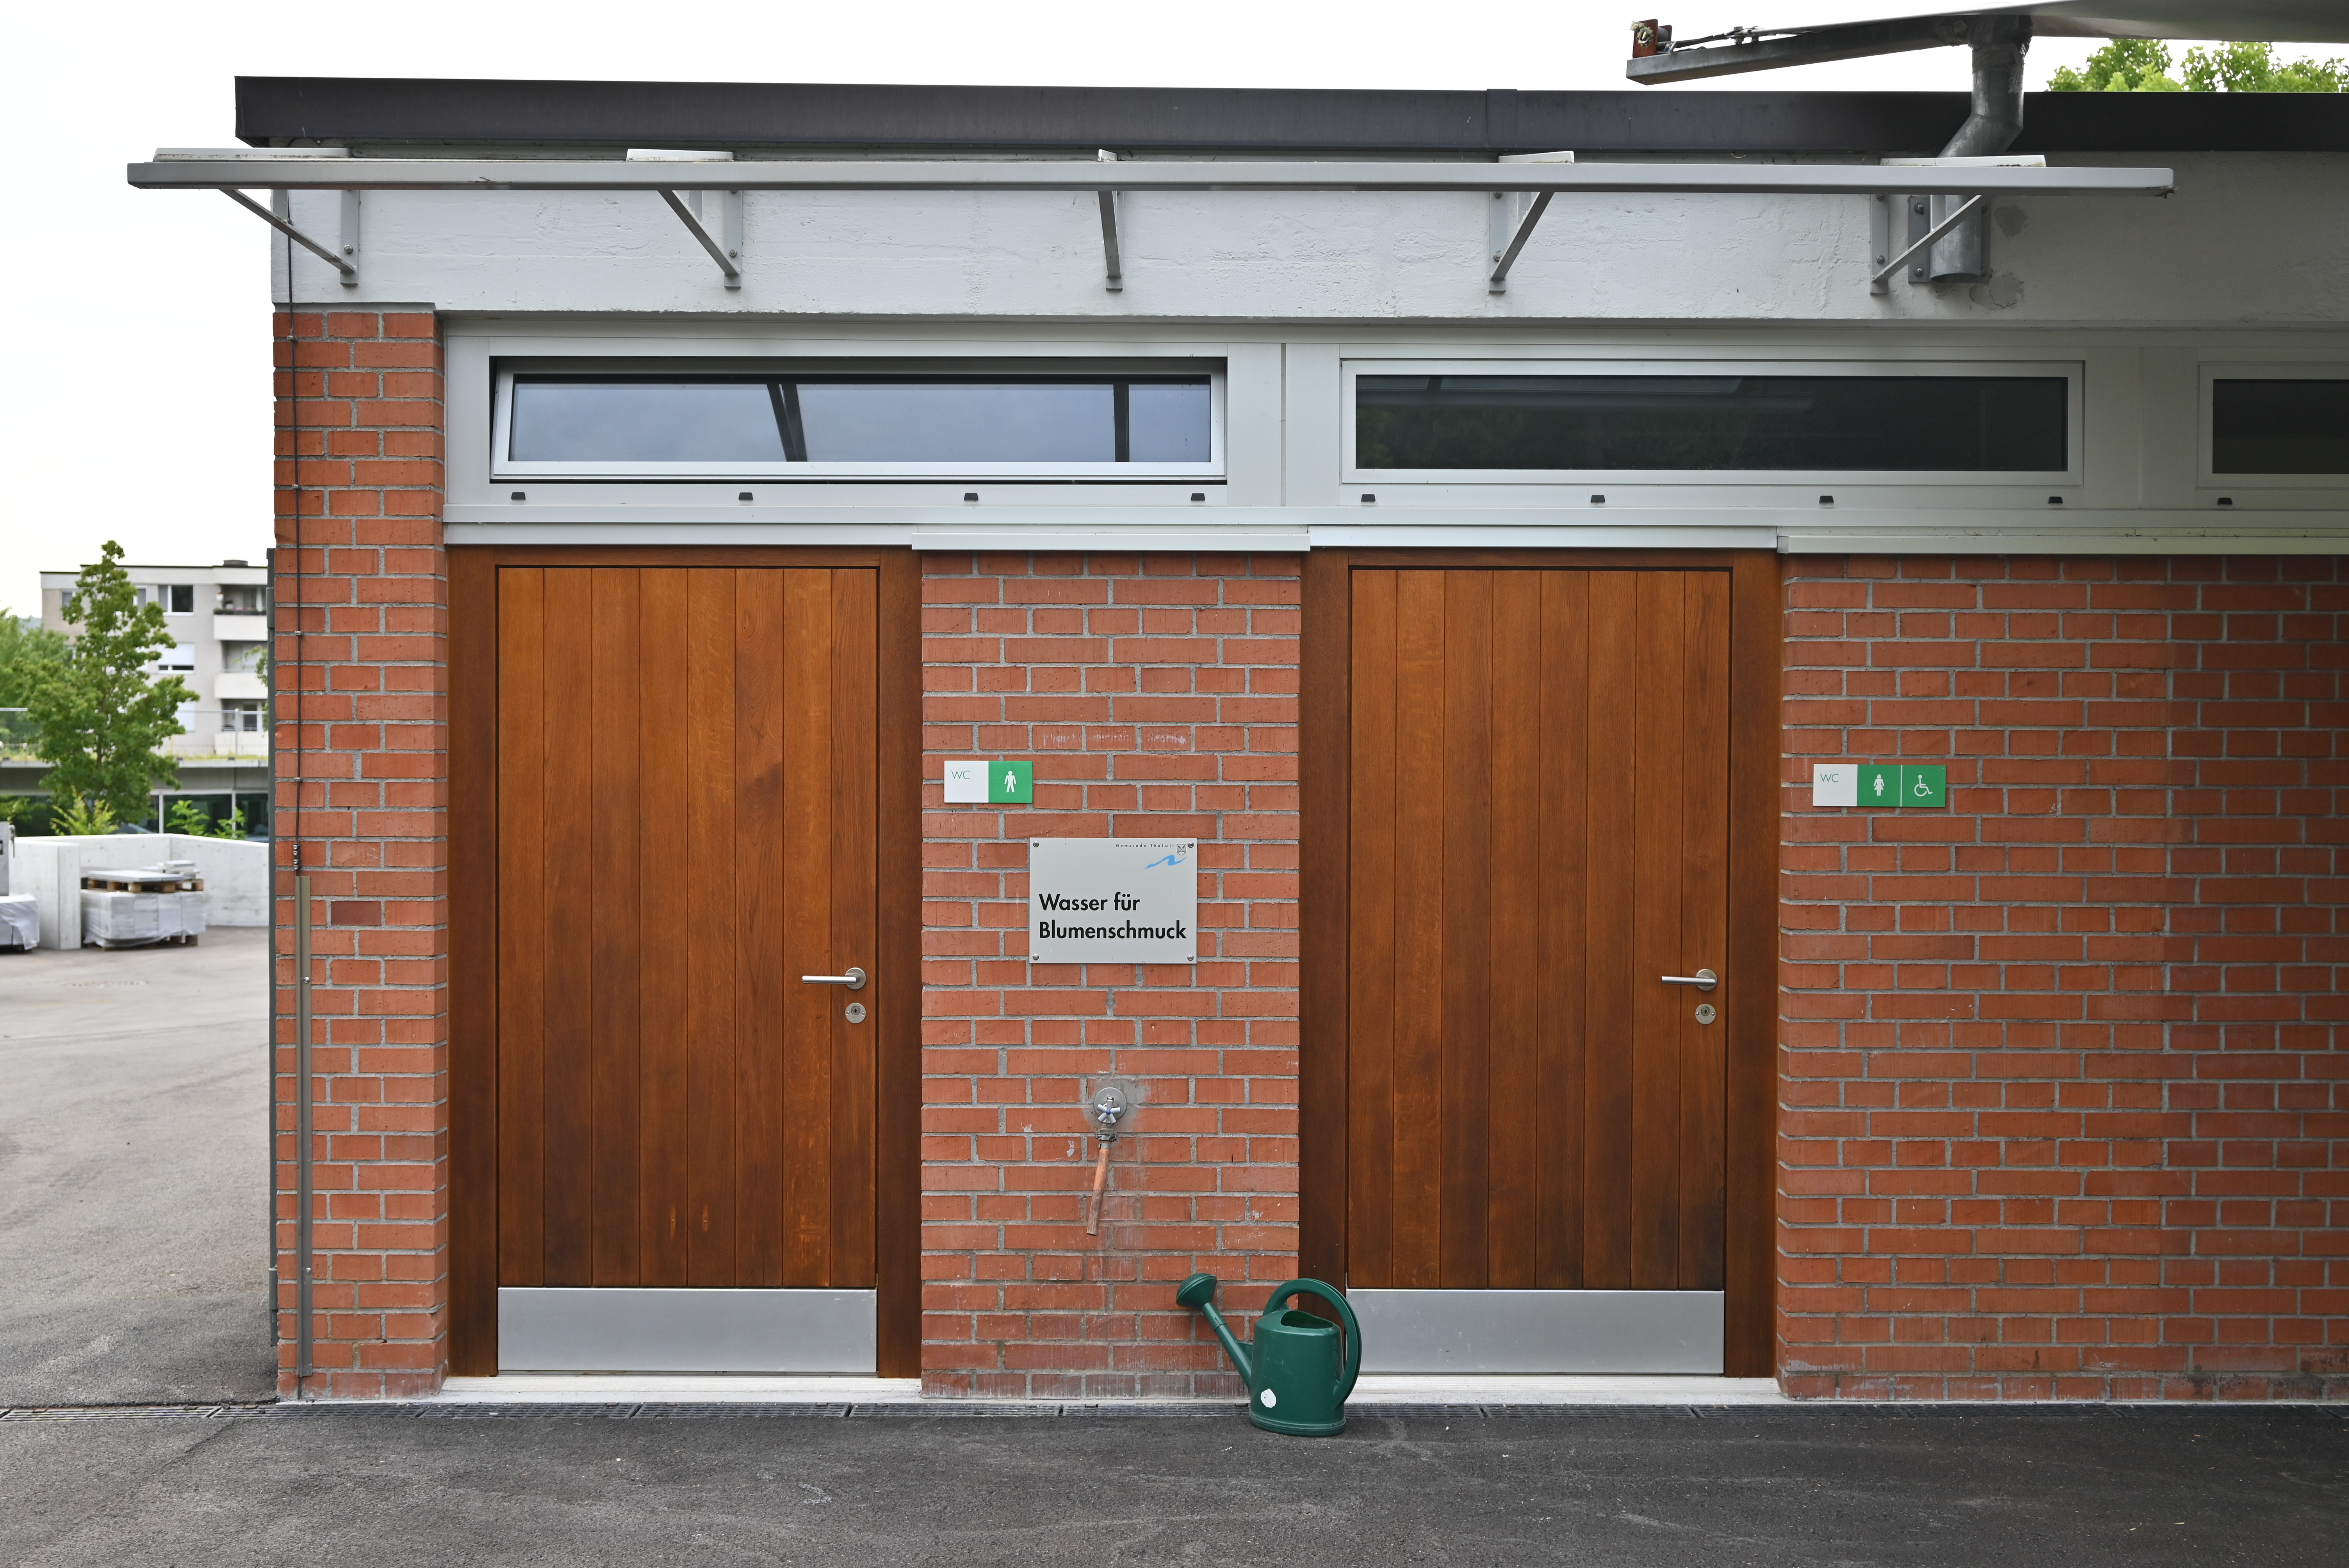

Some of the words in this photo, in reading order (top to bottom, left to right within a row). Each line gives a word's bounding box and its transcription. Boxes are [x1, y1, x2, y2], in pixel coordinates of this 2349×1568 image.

[951, 770, 970, 780] WC
[1820, 773, 1839, 783] WC
[1039, 893, 1108, 911] Wasser
[1114, 892, 1140, 911] für
[1039, 919, 1187, 939] Blumenschmuck
